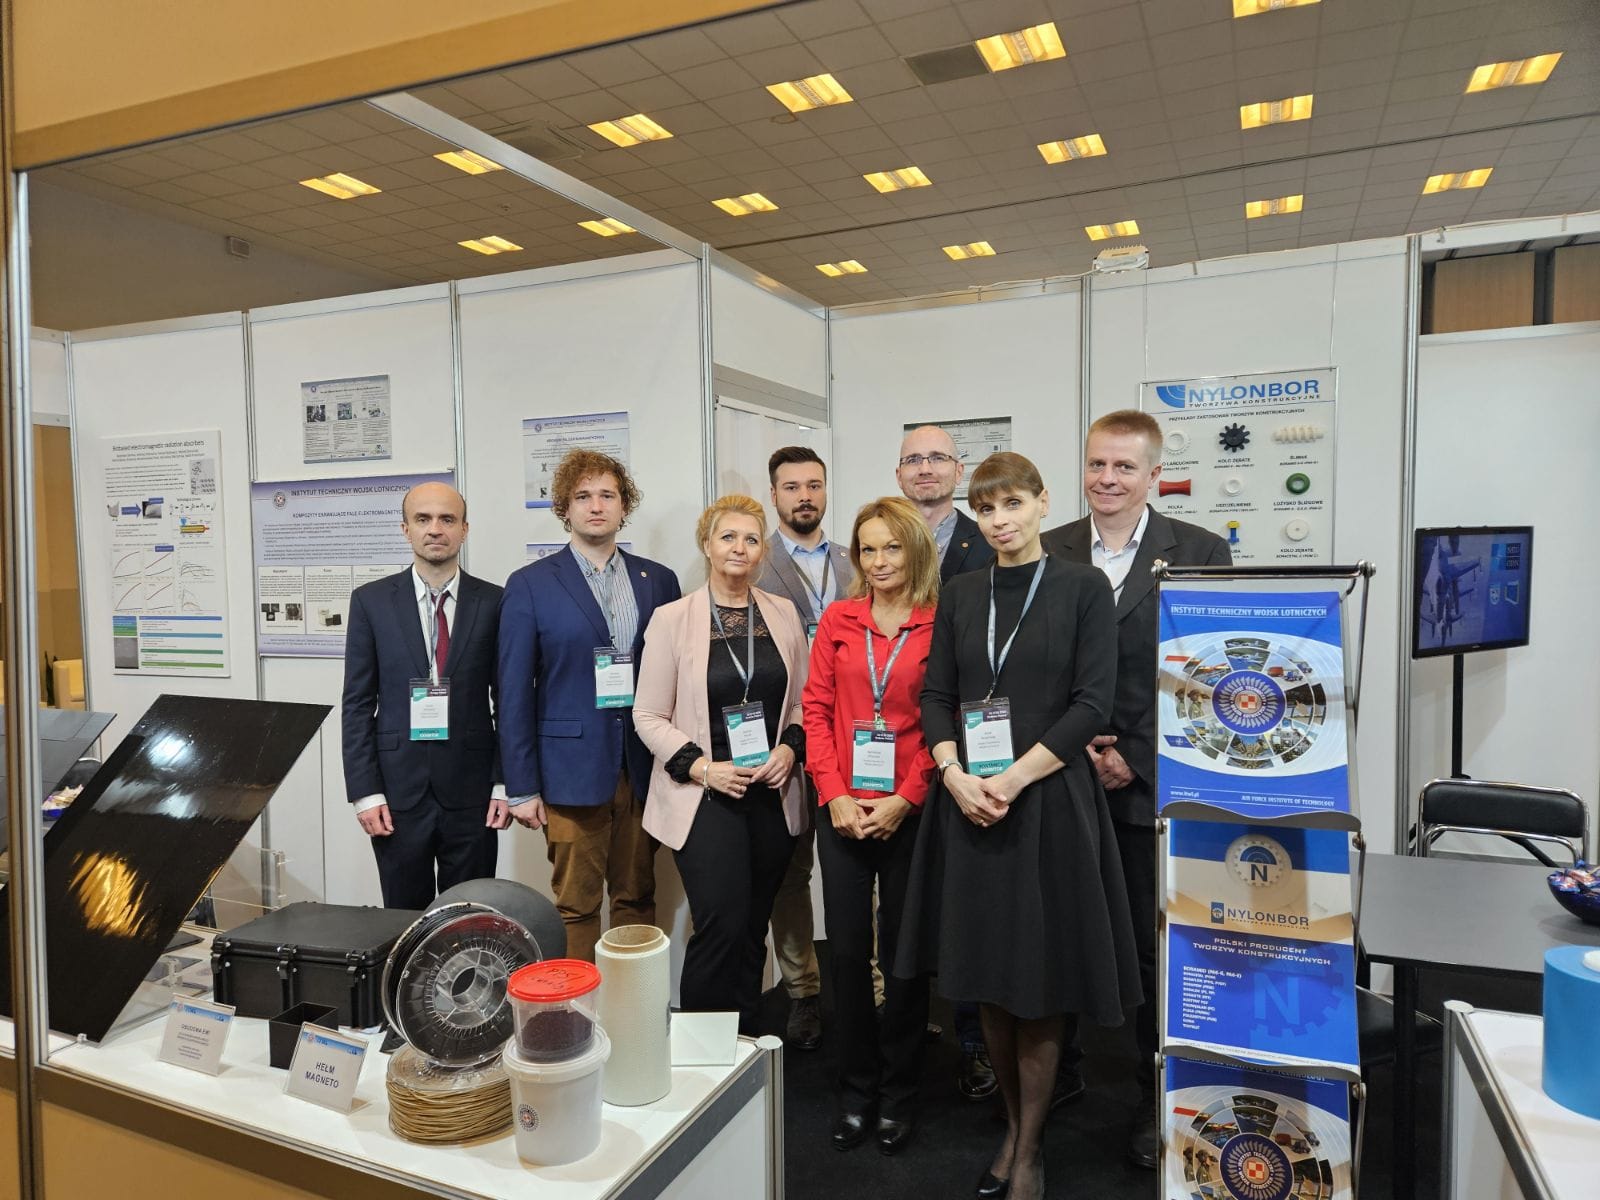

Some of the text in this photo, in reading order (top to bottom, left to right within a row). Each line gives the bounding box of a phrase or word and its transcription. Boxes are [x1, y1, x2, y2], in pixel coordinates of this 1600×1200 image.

[1189, 379, 1319, 402] NYLONBOR
[1243, 394, 1320, 404] KONSTRUKCYJNE
[291, 485, 411, 497] INSTYTUT TECHNICZNY WOJSK LOTNICZYCH
[1171, 605, 1327, 617] INSTYTUT TECHNICZNY WOJSK LOTNICZYCH
[1302, 798, 1334, 807] TECHNOLOGY
[1250, 863, 1268, 882] N
[1227, 907, 1309, 926] NYLONBOR
[1193, 942, 1331, 966] TWORZYW KONSTRUKCYJNYCH
[1214, 937, 1307, 955] POLSKI PRODUCENT
[305, 1070, 340, 1089] MAGNETO
